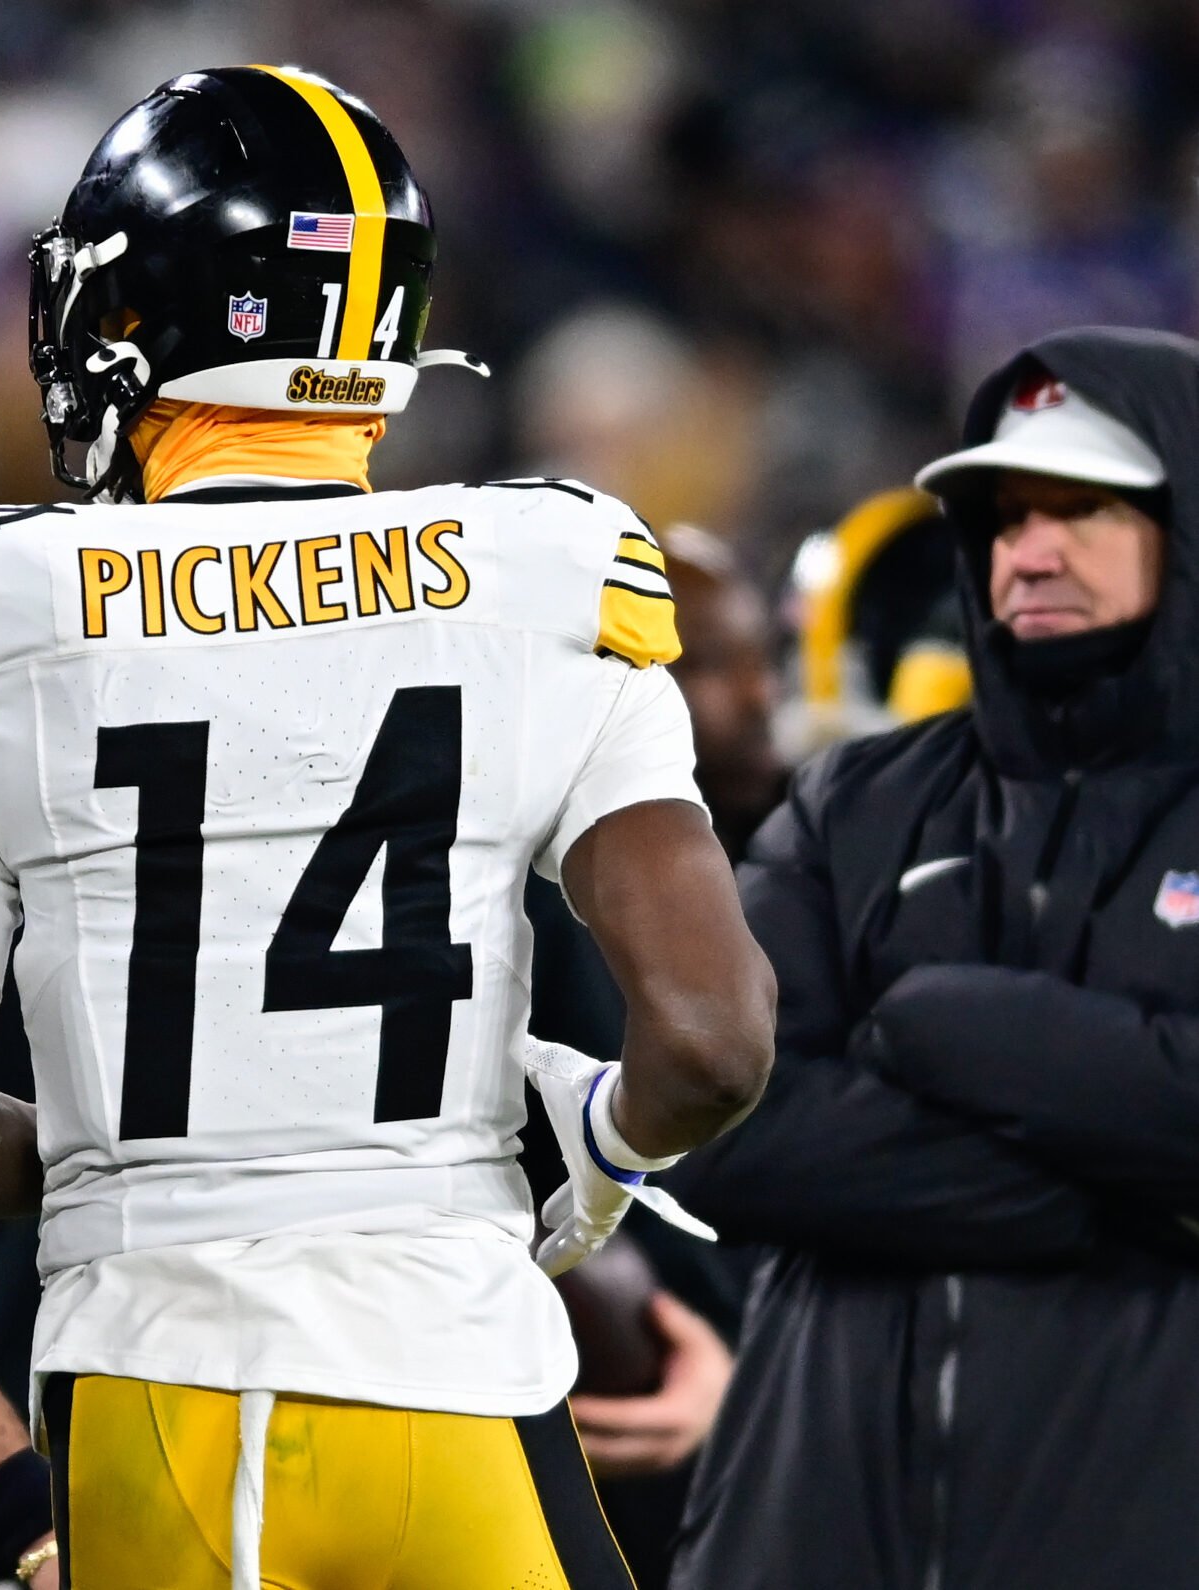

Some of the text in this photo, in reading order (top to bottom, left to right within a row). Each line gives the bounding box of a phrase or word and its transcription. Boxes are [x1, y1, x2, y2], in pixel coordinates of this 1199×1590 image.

[234, 313, 261, 333] NFL
[286, 365, 386, 406] Steelers
[77, 519, 471, 639] PICKENS
[93, 684, 473, 1141] 14
